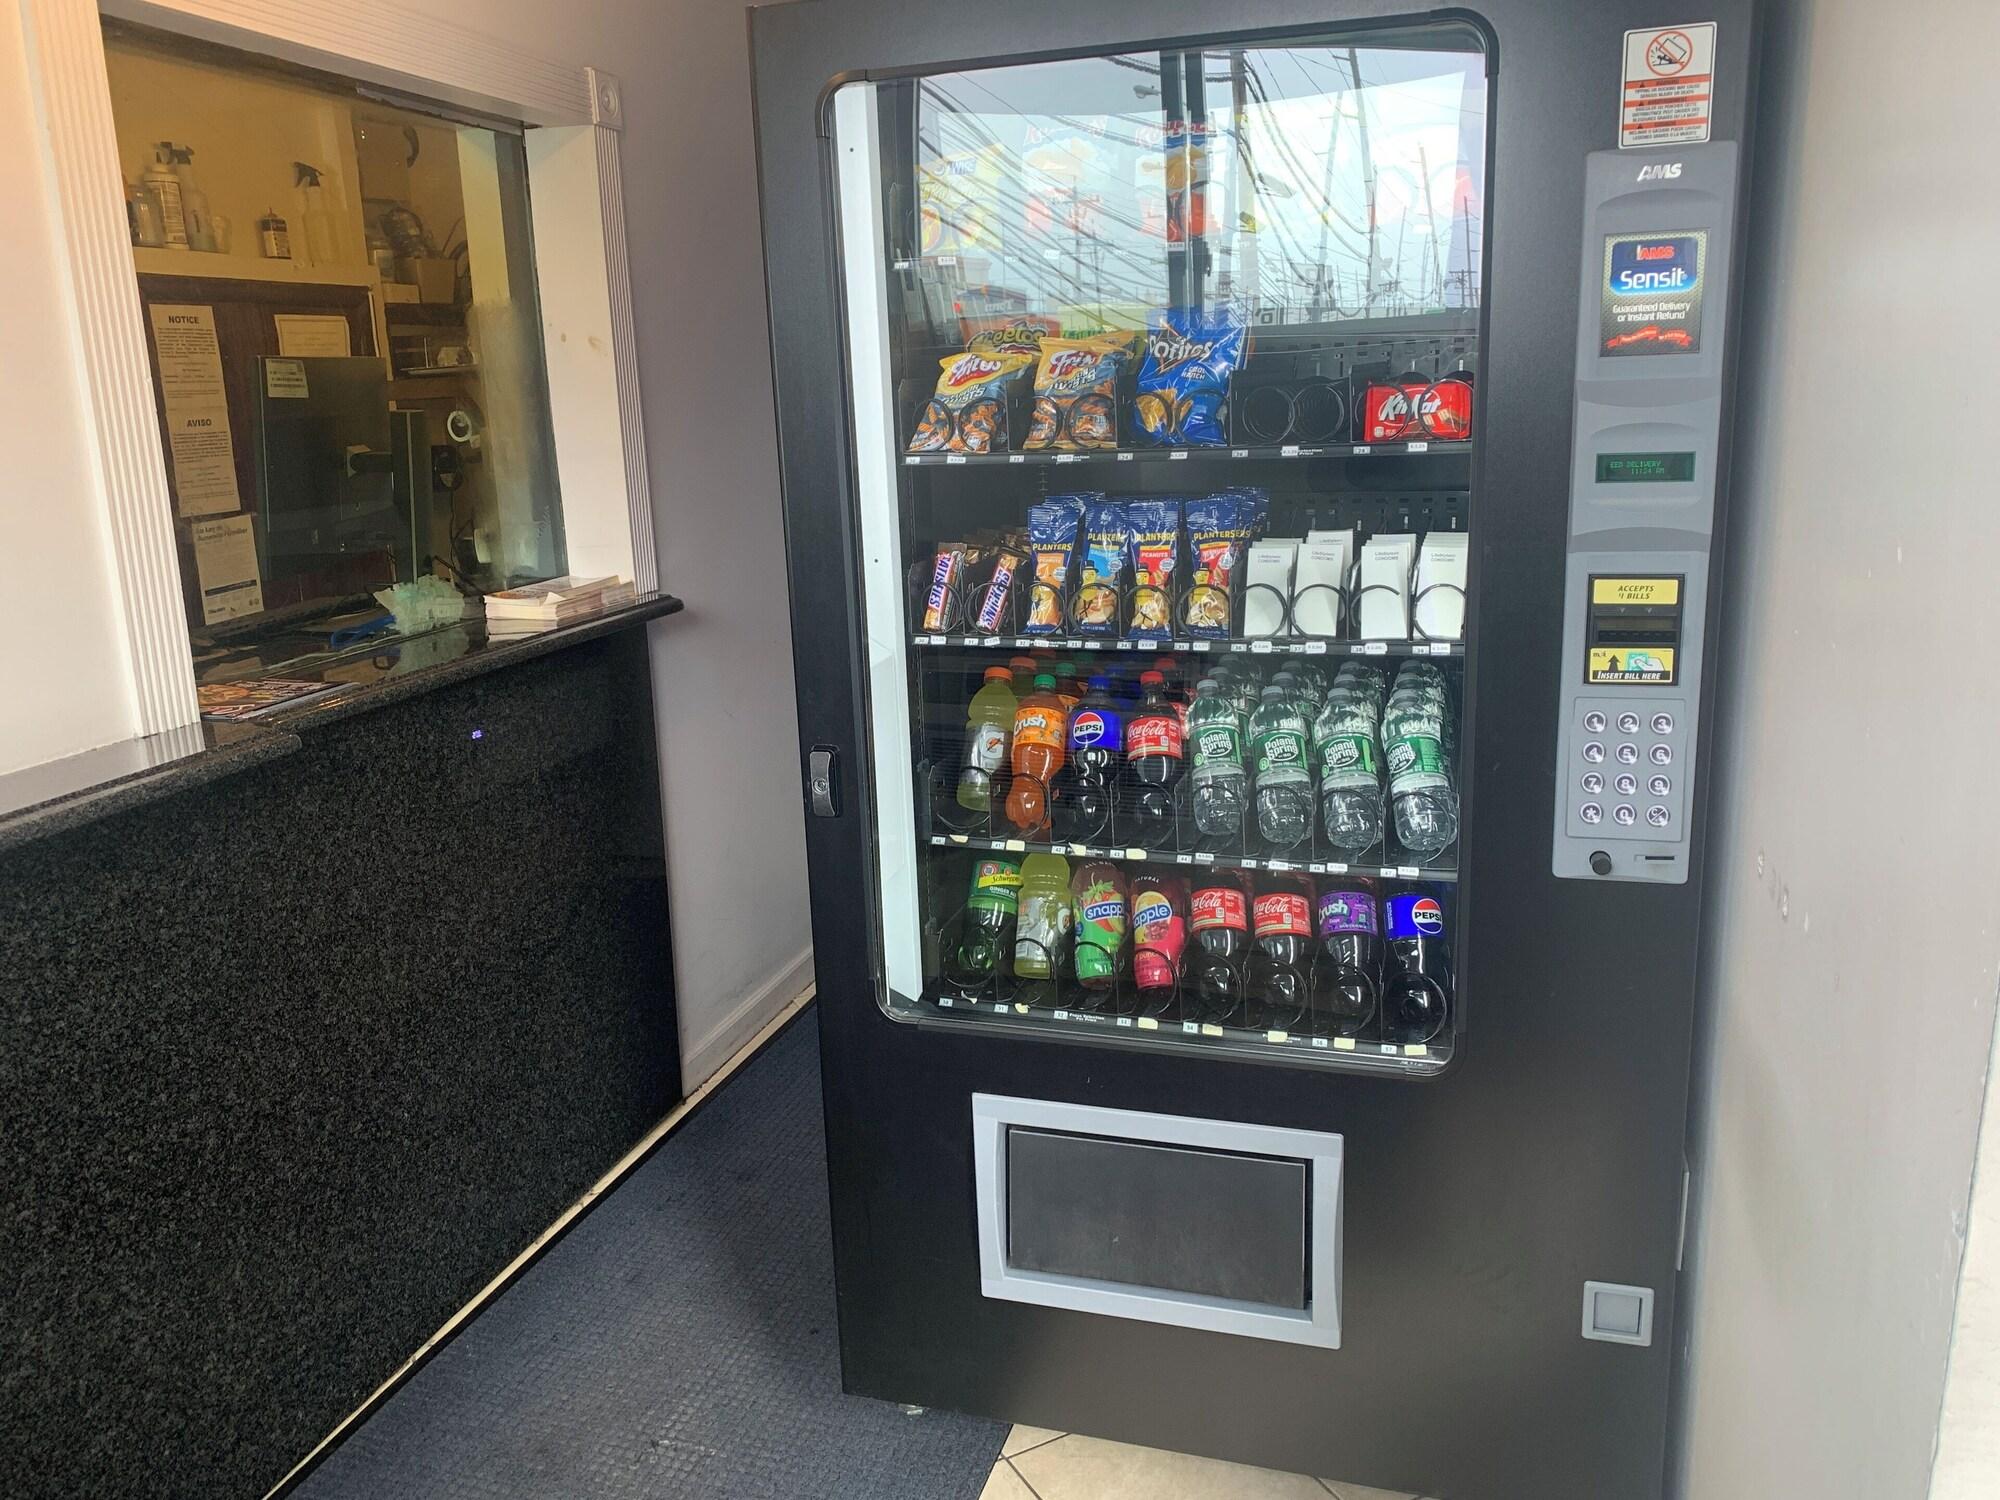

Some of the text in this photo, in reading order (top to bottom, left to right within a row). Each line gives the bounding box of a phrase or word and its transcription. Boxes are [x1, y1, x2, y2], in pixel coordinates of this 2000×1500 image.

[1637, 163, 1682, 182] AMS
[1620, 268, 1685, 290] Sensit
[1612, 302, 1691, 313] Guaranteed Delivery
[168, 315, 200, 324] NOTICE
[1617, 311, 1686, 322] or Instant Refund
[187, 418, 212, 428] AVISO
[1193, 530, 1235, 540] PLANTERS
[1033, 543, 1073, 551] PLANTERS
[1597, 671, 1661, 680] INSERT BILL HERE
[1014, 714, 1047, 737] Crush
[1074, 724, 1103, 734] PEPSI
[1591, 717, 1666, 729] 1 2 3
[1128, 720, 1169, 742] Coca-Cola
[1200, 730, 1230, 746] Poland
[1264, 736, 1296, 750] Poland
[1201, 740, 1232, 756] Spring
[1266, 745, 1299, 760] Spring
[1324, 739, 1356, 755] Poland
[1589, 747, 1664, 760] 4 5 6
[1326, 748, 1359, 767] Spring
[1389, 750, 1416, 773] Spring
[1588, 778, 1663, 790] 7 8 9
[1619, 809, 1628, 819] 0
[989, 886, 1010, 895] GINGER
[1087, 904, 1123, 919] snapp
[1134, 904, 1169, 926] apple
[1414, 911, 1441, 921] PEPS
